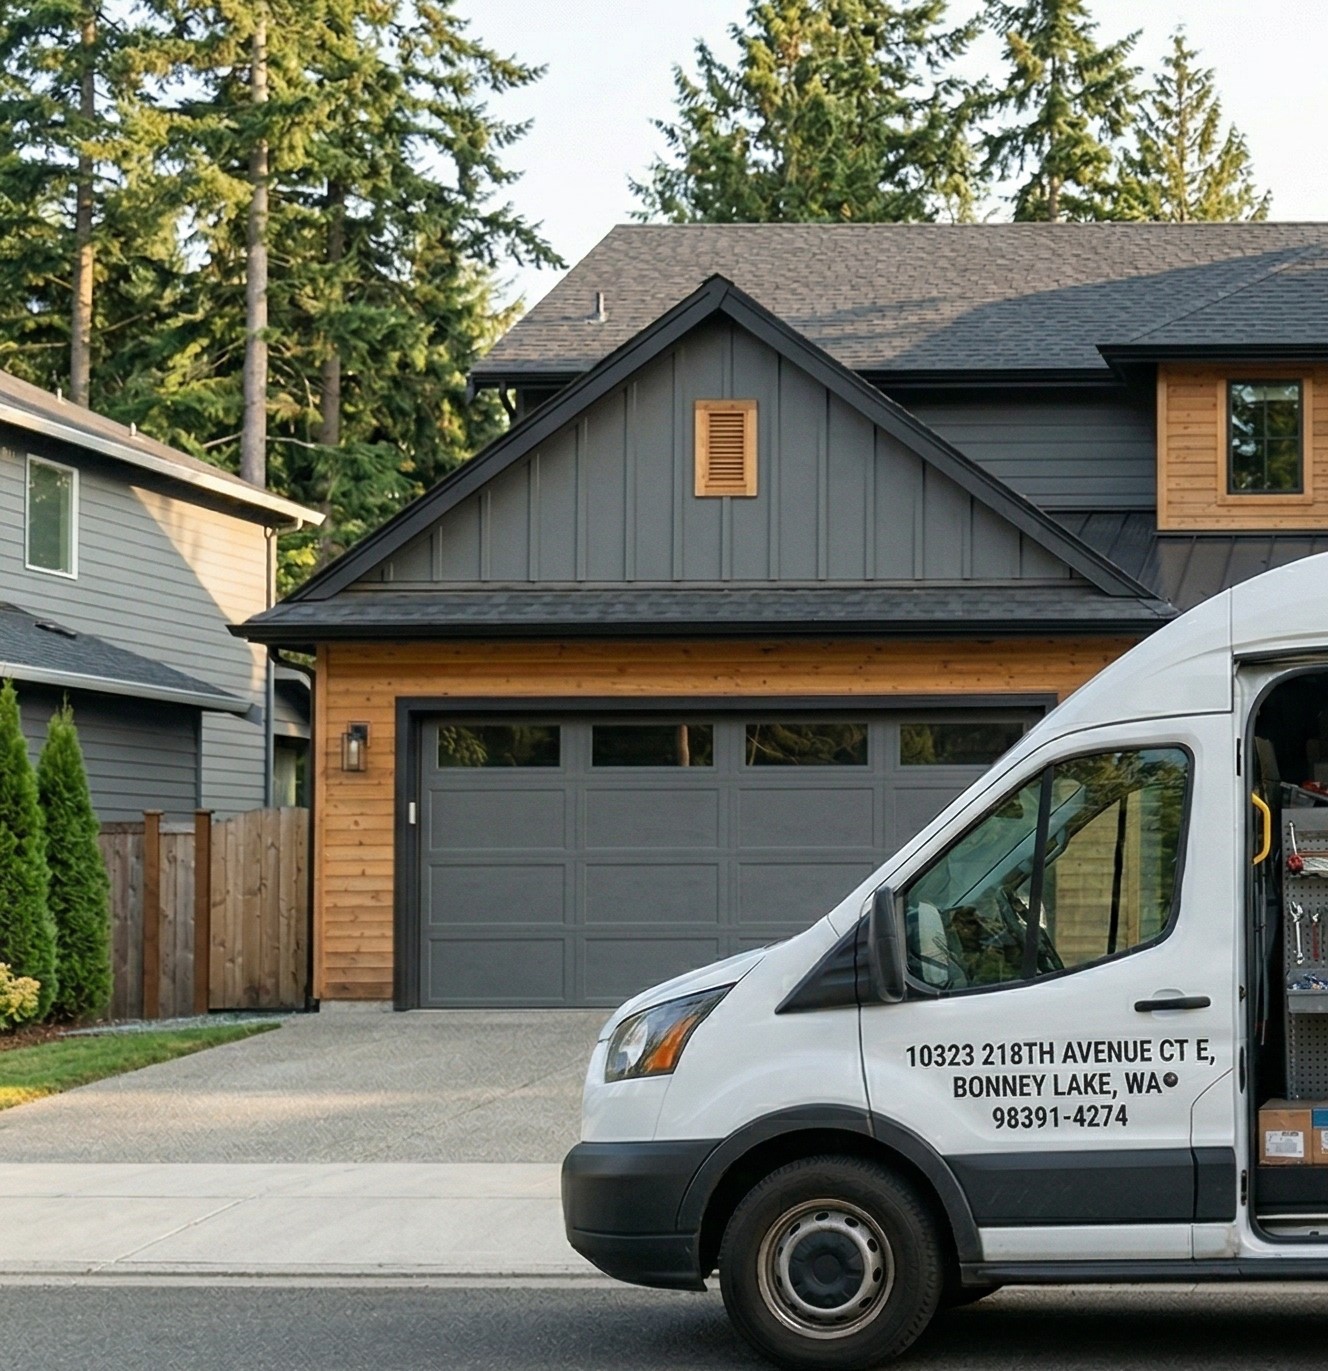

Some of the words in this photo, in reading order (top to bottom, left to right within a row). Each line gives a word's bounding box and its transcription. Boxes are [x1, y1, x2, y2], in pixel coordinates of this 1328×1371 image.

[905, 1043, 975, 1068] 10323
[981, 1041, 1055, 1066] 218TH
[1061, 1039, 1153, 1064] AVENUE
[1159, 1038, 1189, 1062] CT
[1196, 1038, 1216, 1066] E,
[953, 1074, 1047, 1098] BONNEY
[1053, 1072, 1118, 1100] LAKE,
[1124, 1071, 1163, 1095] WA
[992, 1104, 1129, 1130] 98391-4274
